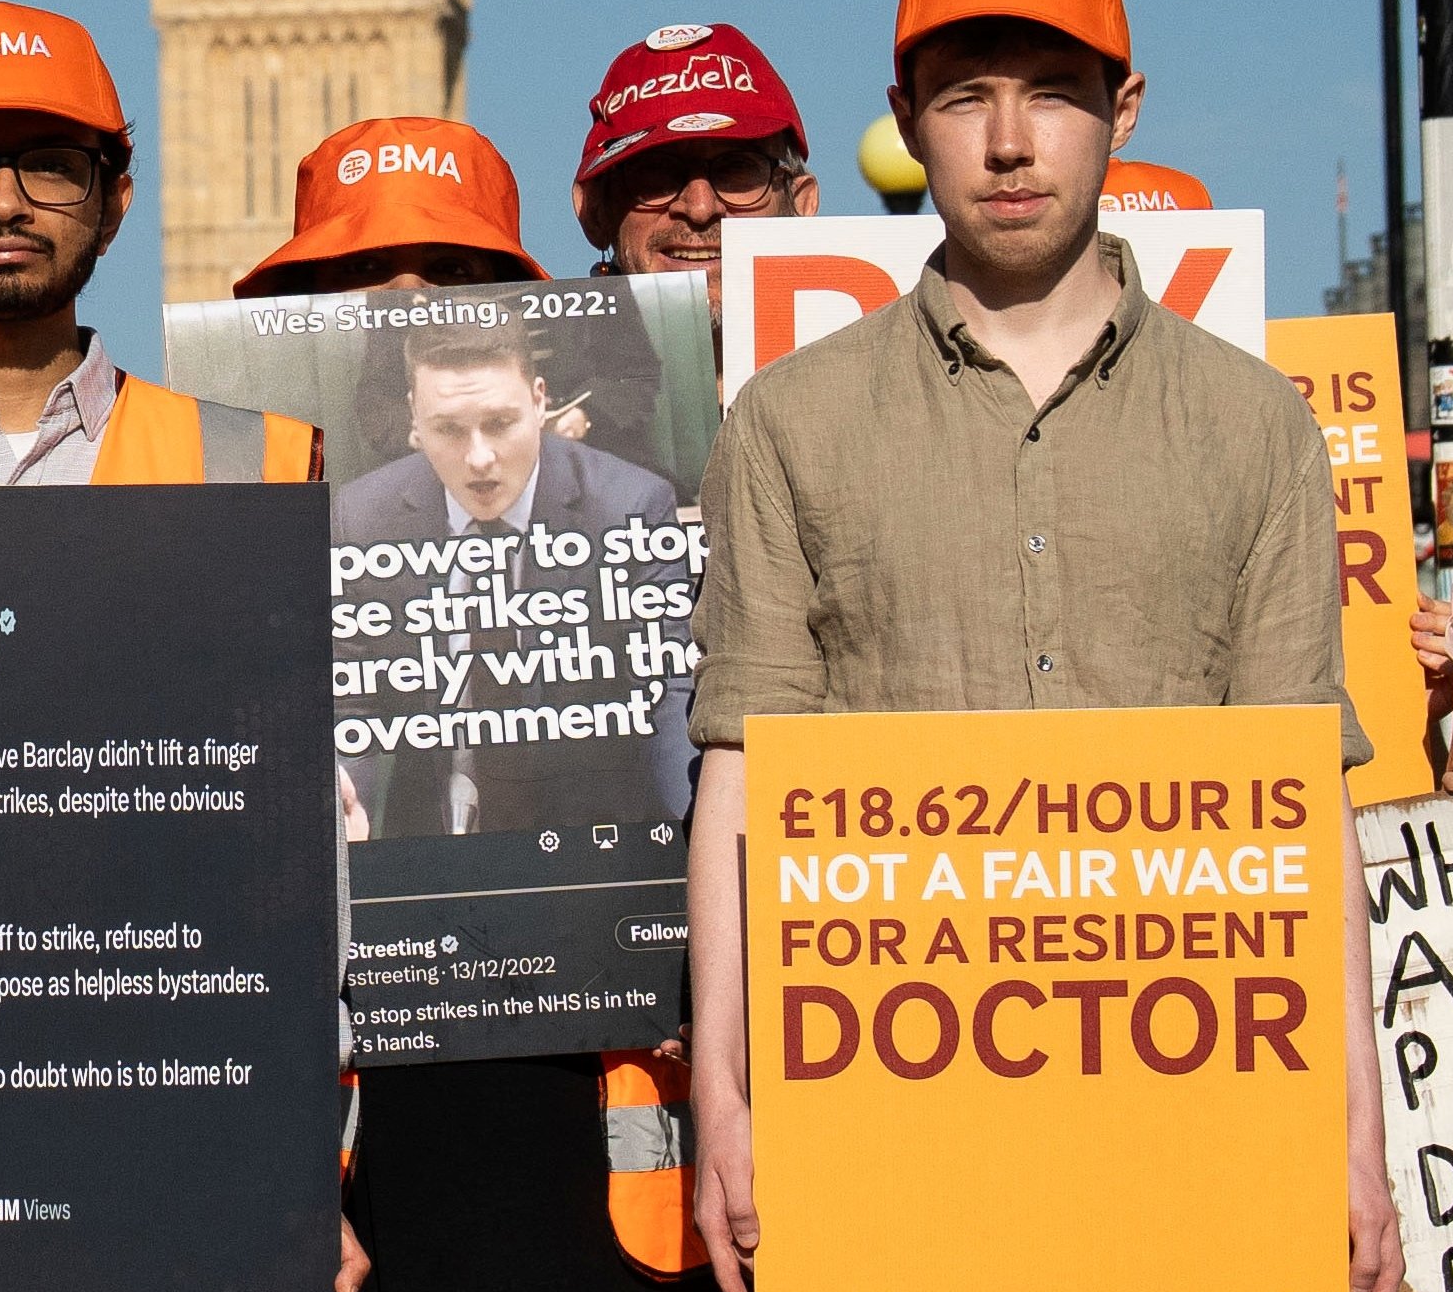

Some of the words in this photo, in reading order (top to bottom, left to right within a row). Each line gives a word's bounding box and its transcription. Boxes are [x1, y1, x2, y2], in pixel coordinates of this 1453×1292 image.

[378, 144, 462, 184] BMA
[1122, 190, 1180, 211] BMA
[252, 310, 325, 336] Wes
[336, 299, 510, 332] Streeting,
[521, 291, 618, 321] 2022:
[1332, 372, 1376, 413] IS
[1322, 424, 1382, 466] GE
[330, 532, 522, 596] power
[530, 522, 592, 568] to
[602, 516, 710, 574] stop
[331, 601, 391, 639] se
[404, 579, 589, 632] strikes
[600, 568, 692, 621] lies
[332, 634, 474, 706] arely
[481, 625, 616, 687] with
[626, 622, 702, 677] the
[24, 740, 93, 773] Barclay
[159, 739, 183, 765] lift
[188, 746, 199, 765] a
[204, 738, 258, 771] finger
[59, 786, 129, 818] despite
[134, 785, 165, 811] the
[170, 784, 244, 811] obvious
[780, 778, 1229, 837] £18.62/HOUR
[1250, 778, 1307, 831] IS
[779, 853, 907, 903] NOT
[921, 853, 966, 900] A
[983, 848, 1116, 899] FAIR
[1131, 845, 1308, 896] WAGE
[17, 927, 36, 950] to
[42, 923, 100, 954] strike,
[106, 922, 176, 949] refused
[182, 924, 201, 948] to
[348, 938, 436, 959] Streeting
[631, 924, 688, 941] Follow
[782, 917, 907, 967] FOR
[924, 917, 969, 964] A
[989, 910, 1307, 963] RESIDENT
[48, 977, 69, 996] as
[75, 968, 152, 1001] helpless
[159, 966, 269, 1001] bystanders.
[347, 965, 439, 986] sstreeting
[450, 956, 556, 980] 13/12/2022
[371, 1008, 411, 1026] stop
[417, 1002, 477, 1020] strikes
[482, 999, 498, 1016] in
[503, 997, 533, 1014] the
[539, 994, 581, 1012] NHS
[585, 992, 600, 1009] is
[605, 991, 621, 1008] in
[626, 989, 656, 1006] the
[377, 1031, 440, 1051] hands.
[782, 976, 1309, 1081] DOCTOR
[11, 1061, 67, 1088] doubt
[72, 1060, 112, 1086] who
[118, 1060, 132, 1086] is
[137, 1062, 156, 1086] to
[163, 1059, 220, 1085] blame
[225, 1058, 252, 1084] for
[24, 1199, 70, 1220] Views
